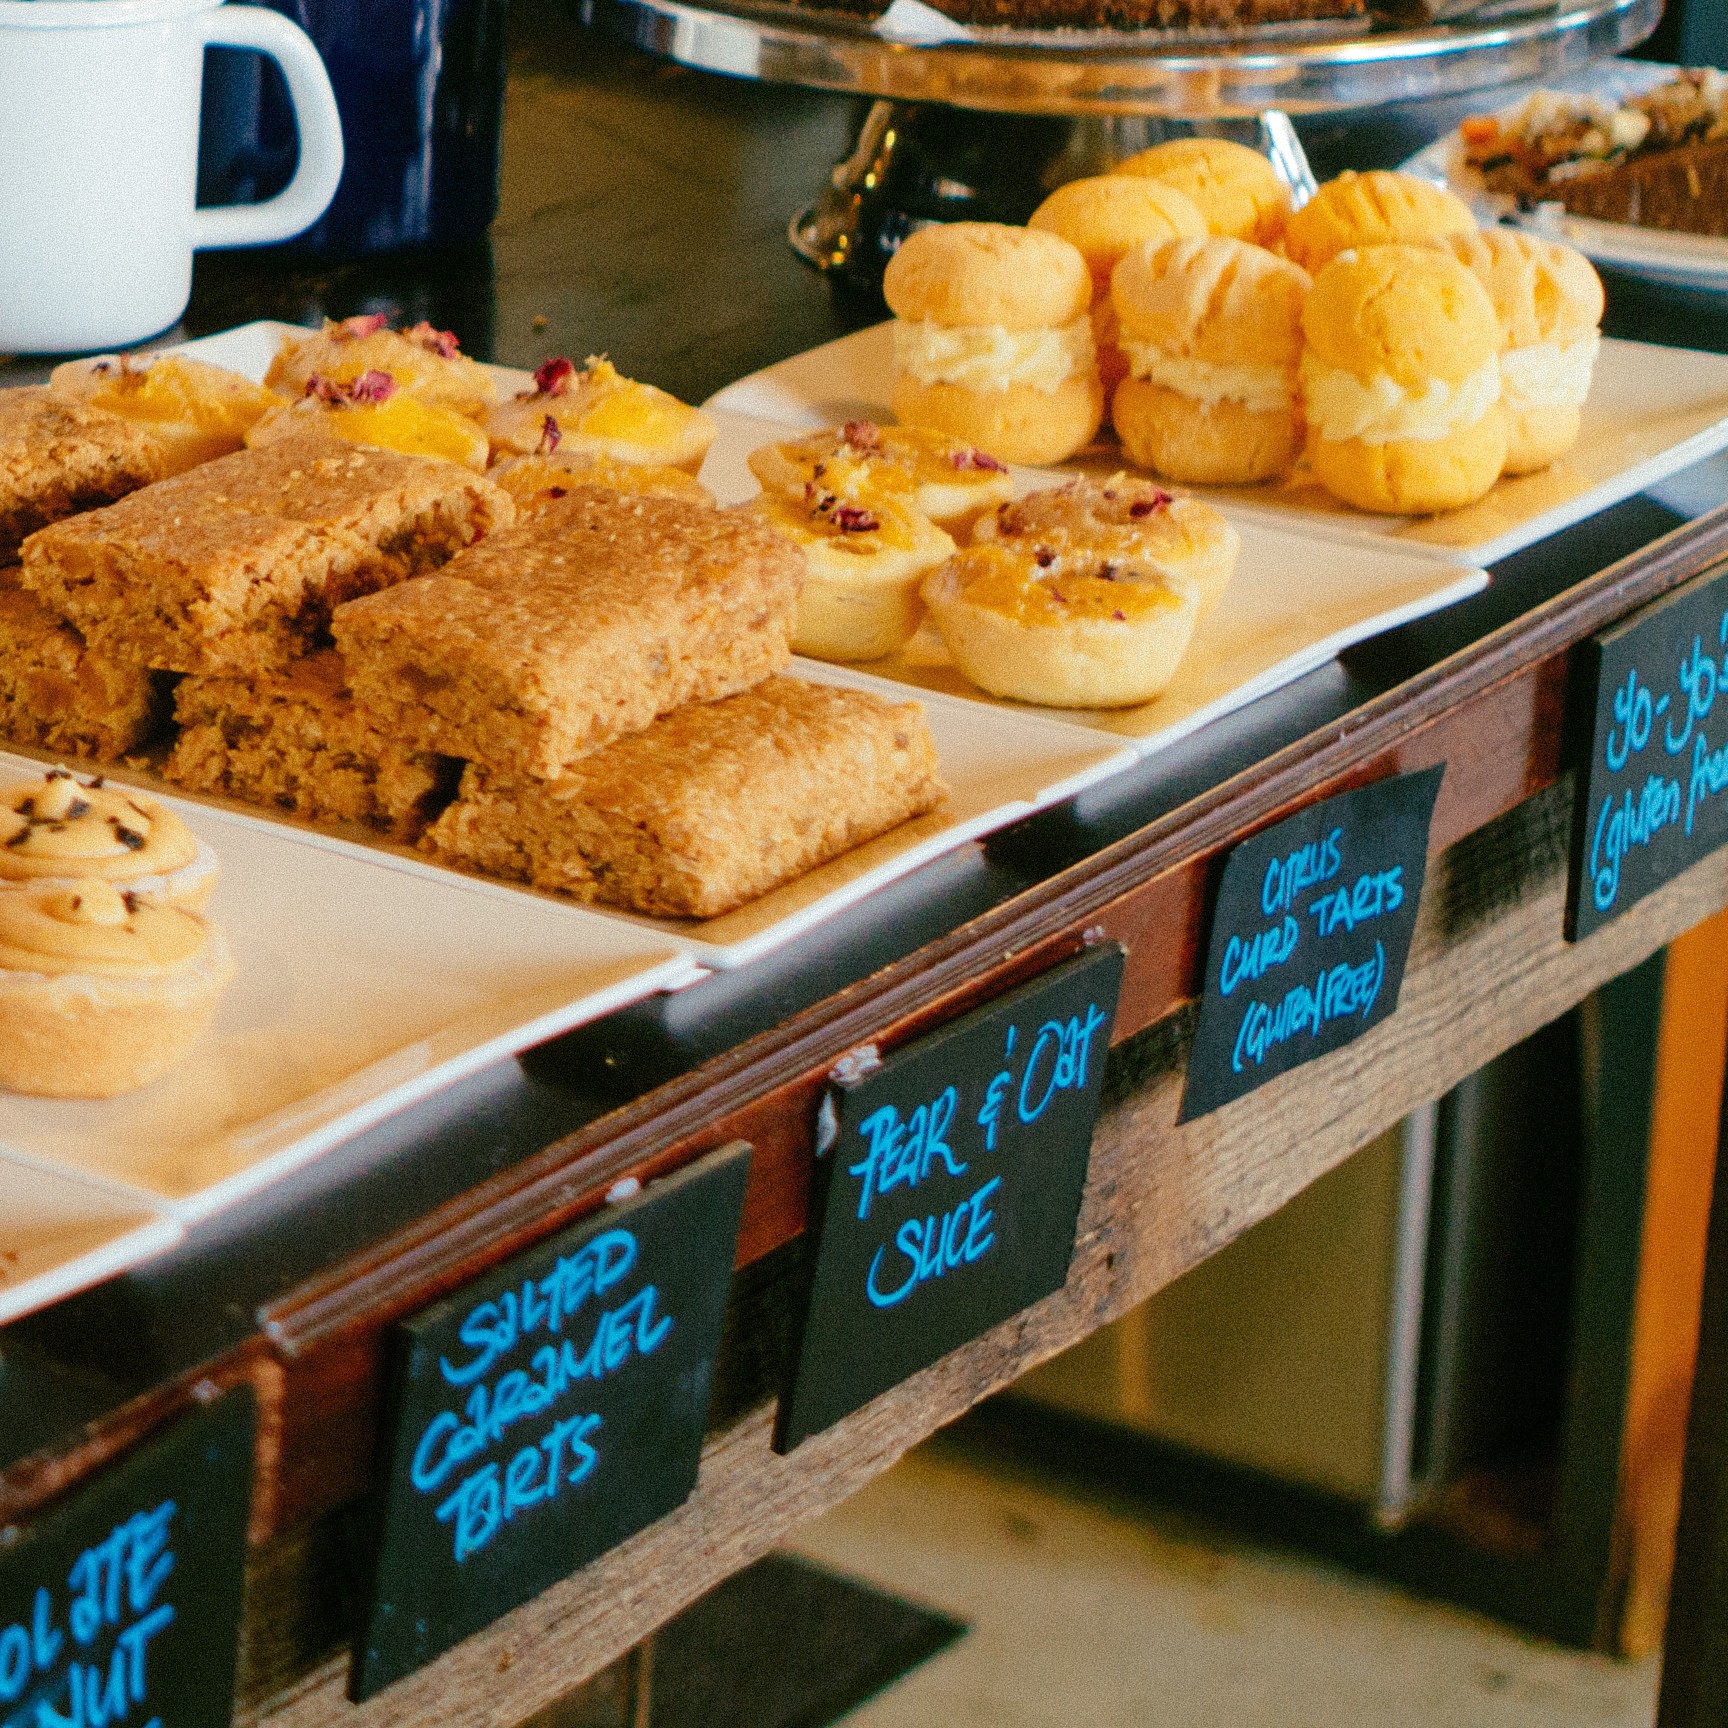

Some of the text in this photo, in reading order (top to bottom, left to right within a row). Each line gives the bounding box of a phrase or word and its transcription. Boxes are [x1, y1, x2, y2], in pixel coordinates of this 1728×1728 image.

[1260, 825, 1344, 917] CITRUS
[1218, 913, 1301, 999] CURD
[864, 1174, 1004, 1310] SLICE
